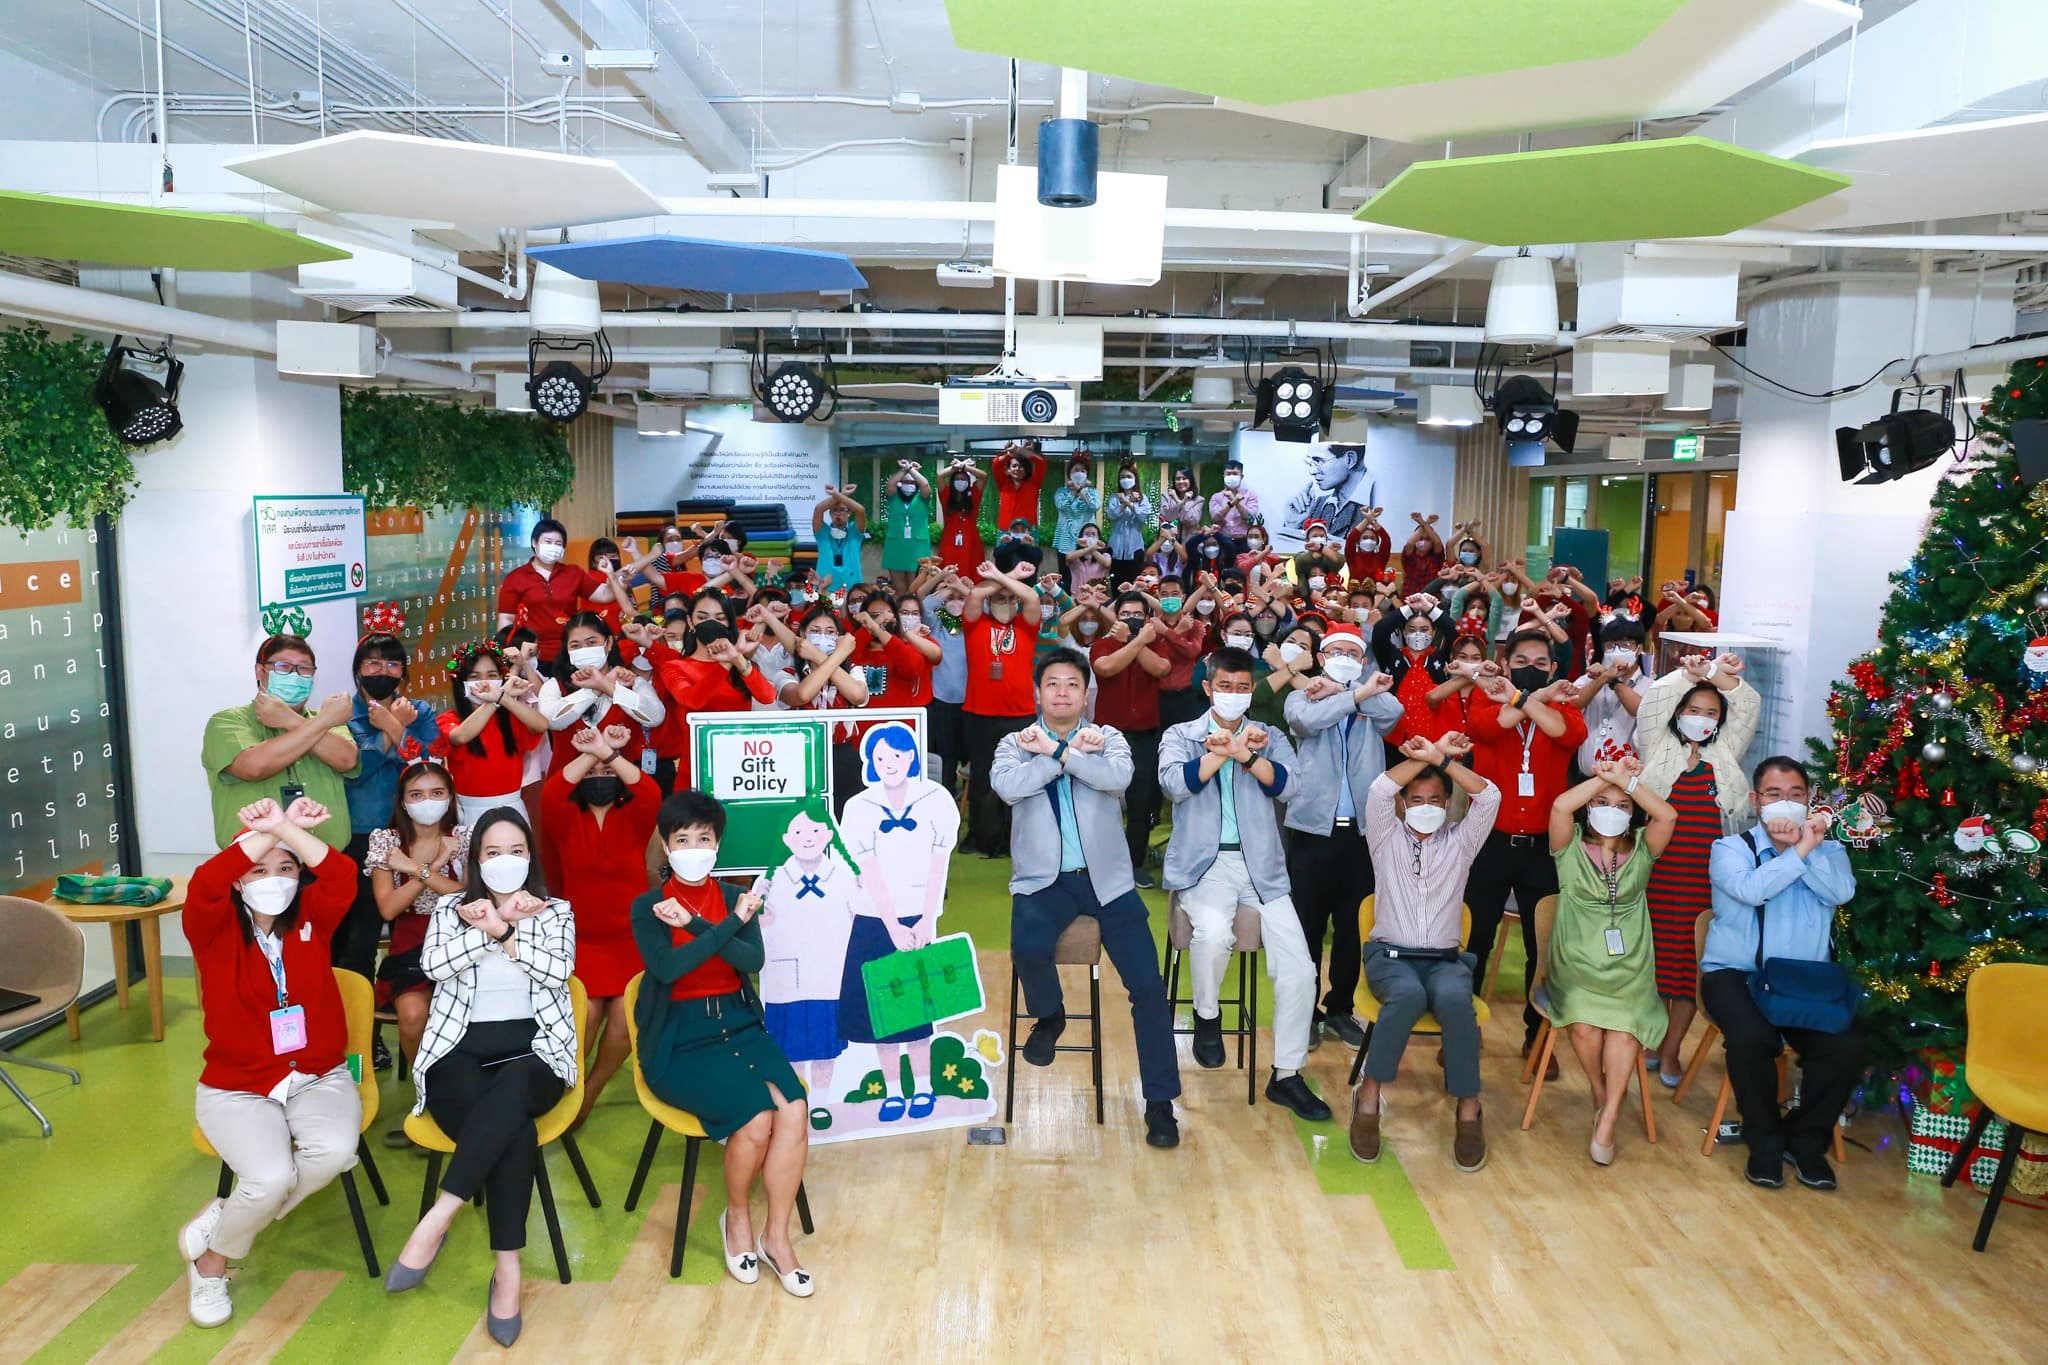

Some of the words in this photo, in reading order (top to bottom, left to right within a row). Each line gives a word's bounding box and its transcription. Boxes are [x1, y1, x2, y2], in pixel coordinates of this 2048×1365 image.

[744, 740, 773, 756] NO
[741, 756, 777, 773] Gift
[732, 774, 788, 794] Policy
